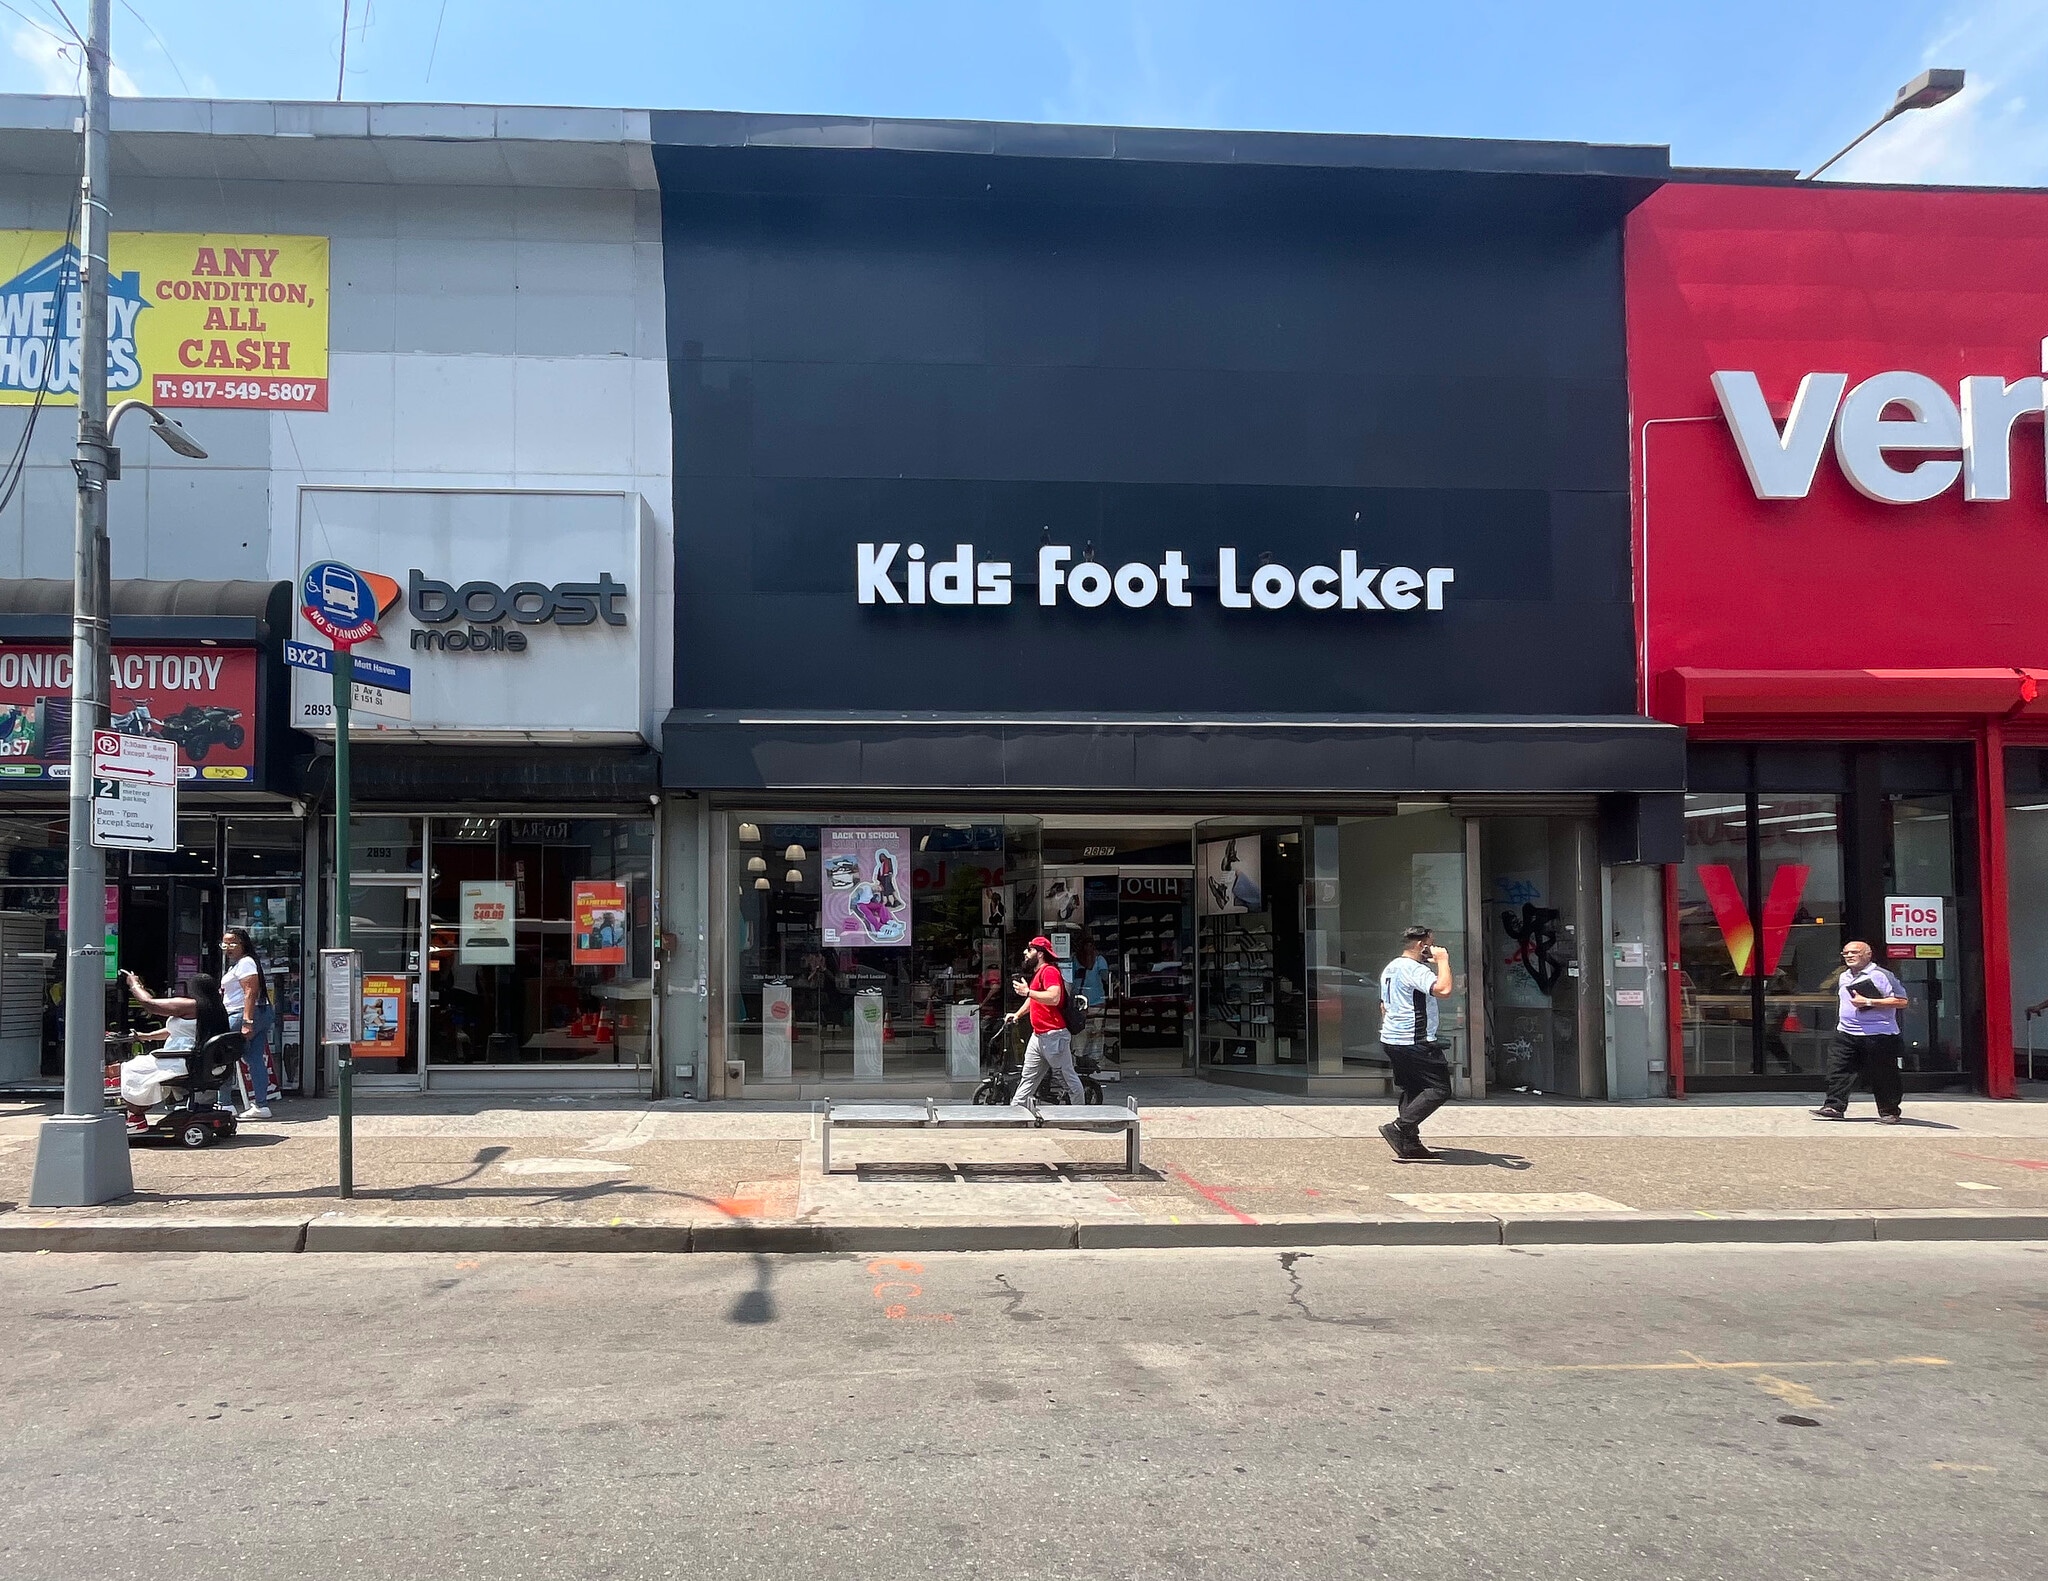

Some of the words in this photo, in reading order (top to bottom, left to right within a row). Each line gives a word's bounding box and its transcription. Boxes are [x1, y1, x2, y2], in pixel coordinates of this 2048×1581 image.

[192, 248, 279, 277] ANY
[156, 280, 315, 308] CONDITION,
[0, 292, 54, 337] WE
[203, 307, 266, 332] ALL
[178, 337, 291, 371] CA$H
[157, 380, 178, 398] T:
[181, 381, 317, 401] 917-549-5807
[1710, 337, 2048, 504] ver
[857, 542, 1012, 605] Kids
[1039, 545, 1192, 609] Foot
[1218, 547, 1455, 612] Locker
[409, 569, 627, 626] boost
[311, 610, 325, 626] NO
[325, 622, 372, 640] STANDING
[410, 626, 528, 651] mobile
[287, 646, 327, 669] BX21
[0, 653, 73, 689] ONIC
[110, 654, 224, 691] ACTORY
[354, 659, 372, 671] Mott
[373, 663, 396, 676] Haven
[355, 693, 360, 701] E
[361, 695, 373, 704] 151
[375, 697, 383, 706] St
[363, 686, 373, 695] Av
[377, 689, 383, 697] &
[304, 704, 332, 716] 2893
[13, 739, 30, 756] S7
[124, 749, 146, 758] Except
[147, 753, 169, 762] Sunday
[100, 779, 113, 797] 2
[122, 789, 151, 797] metered
[122, 796, 147, 804] parking
[97, 807, 115, 816] 8am
[122, 809, 138, 818] 7pm
[97, 817, 124, 827] Except
[126, 820, 154, 830] Sunday
[832, 831, 854, 840] BACK
[855, 831, 867, 840] TO
[868, 831, 900, 840] SCHOOL
[366, 847, 392, 858] 2893
[1083, 846, 1116, 856] 2897
[1891, 903, 1938, 923] Fios
[1891, 924, 1903, 937] is
[1906, 924, 1938, 937] here
